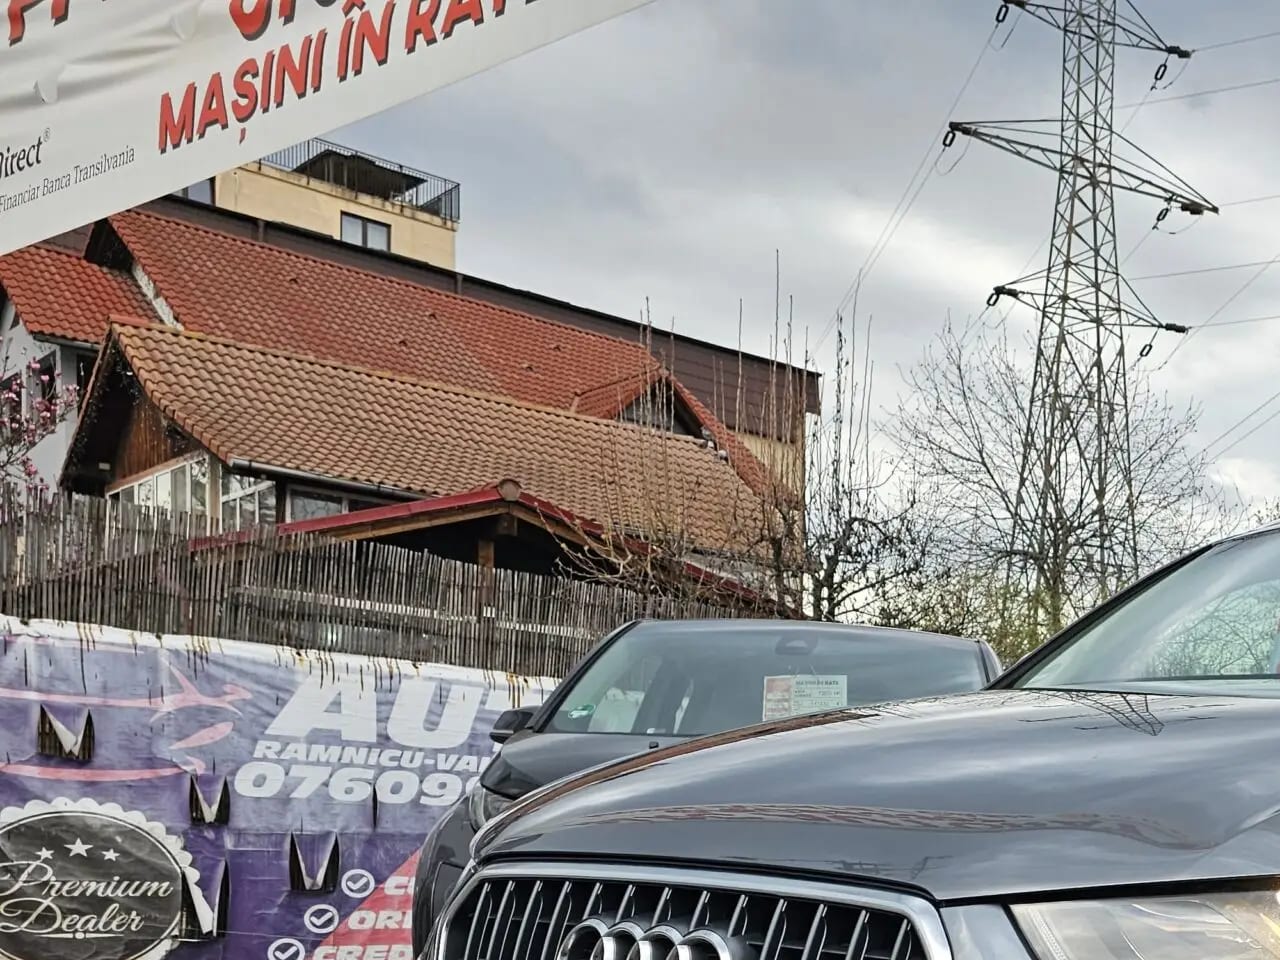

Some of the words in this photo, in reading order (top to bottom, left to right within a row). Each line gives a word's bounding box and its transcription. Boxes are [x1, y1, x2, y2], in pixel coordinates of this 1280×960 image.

[158, 28, 327, 155] MAȘINI
[337, 0, 397, 83] ÎN
[404, 0, 532, 55] RA
[42, 177, 71, 197] Banca
[73, 145, 135, 185] Transilvania
[0, 860, 174, 897] Premium
[0, 897, 145, 933] Dealer
